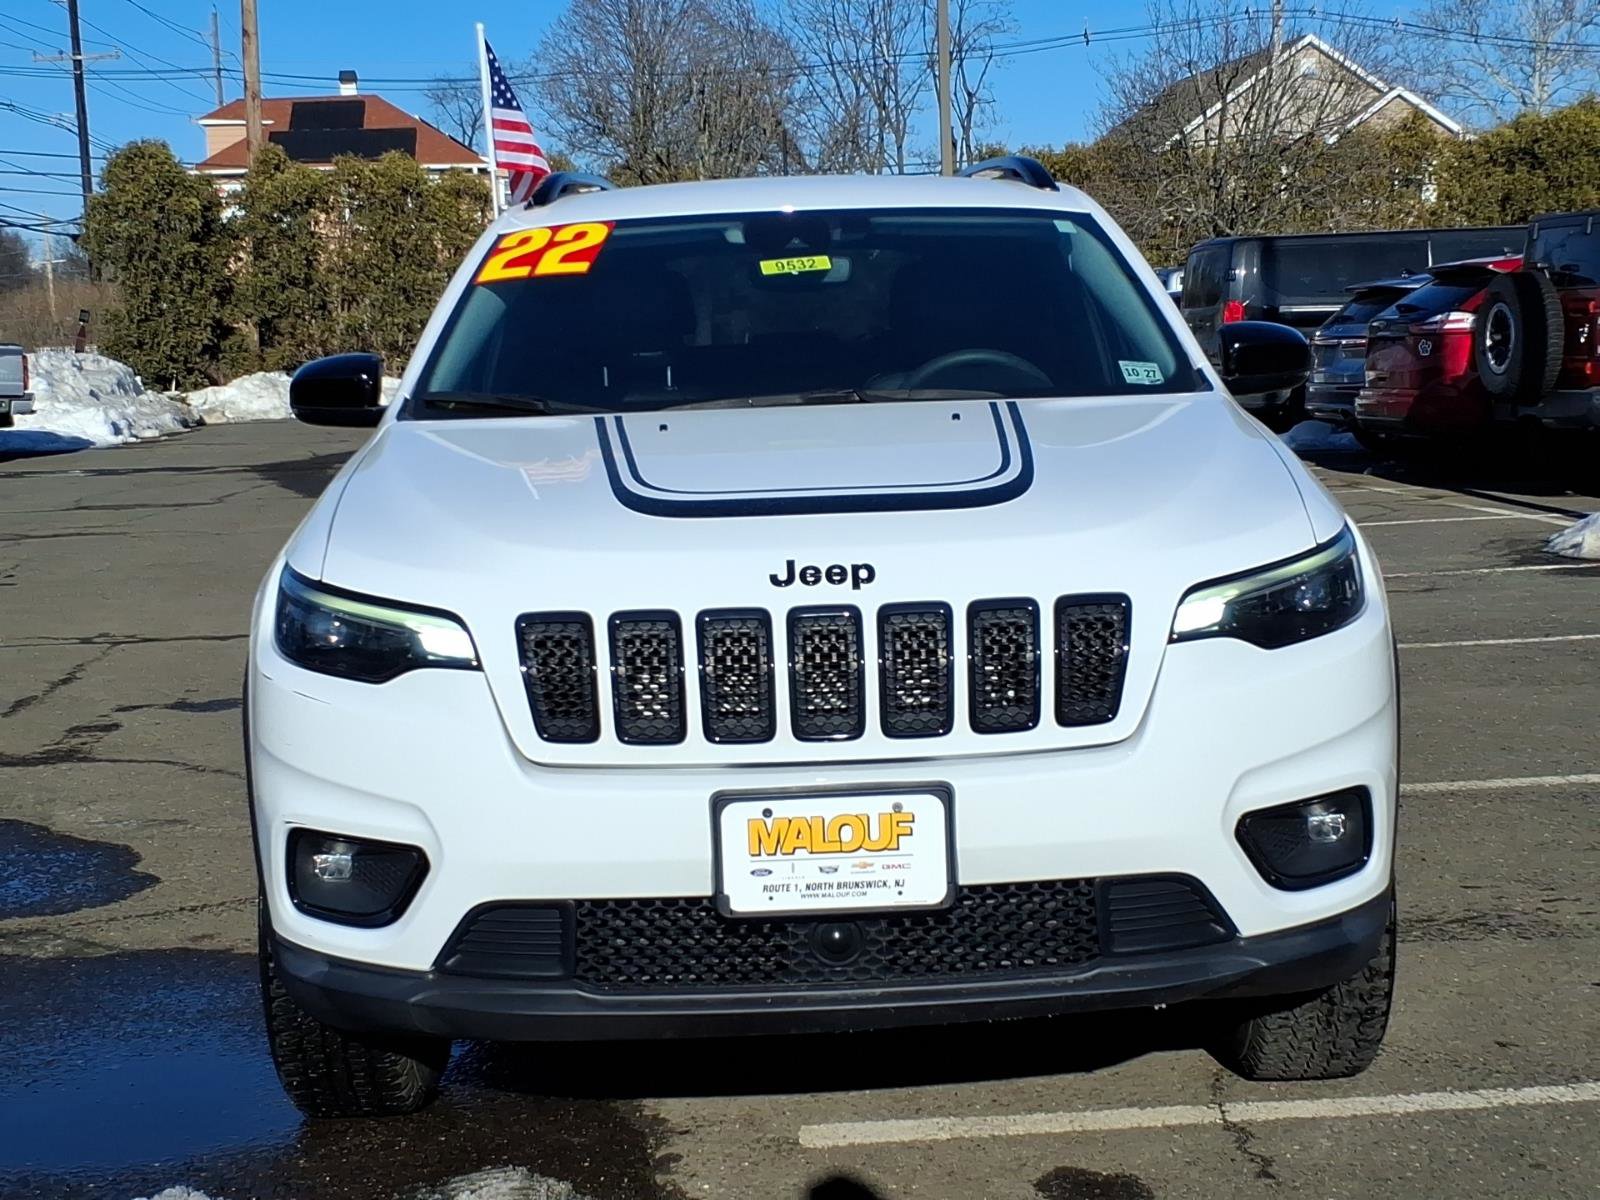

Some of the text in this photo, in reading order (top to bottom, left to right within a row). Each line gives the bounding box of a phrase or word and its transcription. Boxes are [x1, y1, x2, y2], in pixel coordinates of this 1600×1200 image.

[475, 221, 609, 284] 22
[775, 258, 816, 272] 9532
[1125, 368, 1157, 378] 10 27
[769, 559, 876, 590] Jeep
[748, 812, 915, 856] MALOUF
[763, 883, 791, 893] ROUTE
[805, 881, 834, 891] NORTH
[836, 879, 891, 890] BRUNSWICK,
[895, 878, 905, 888] NJ
